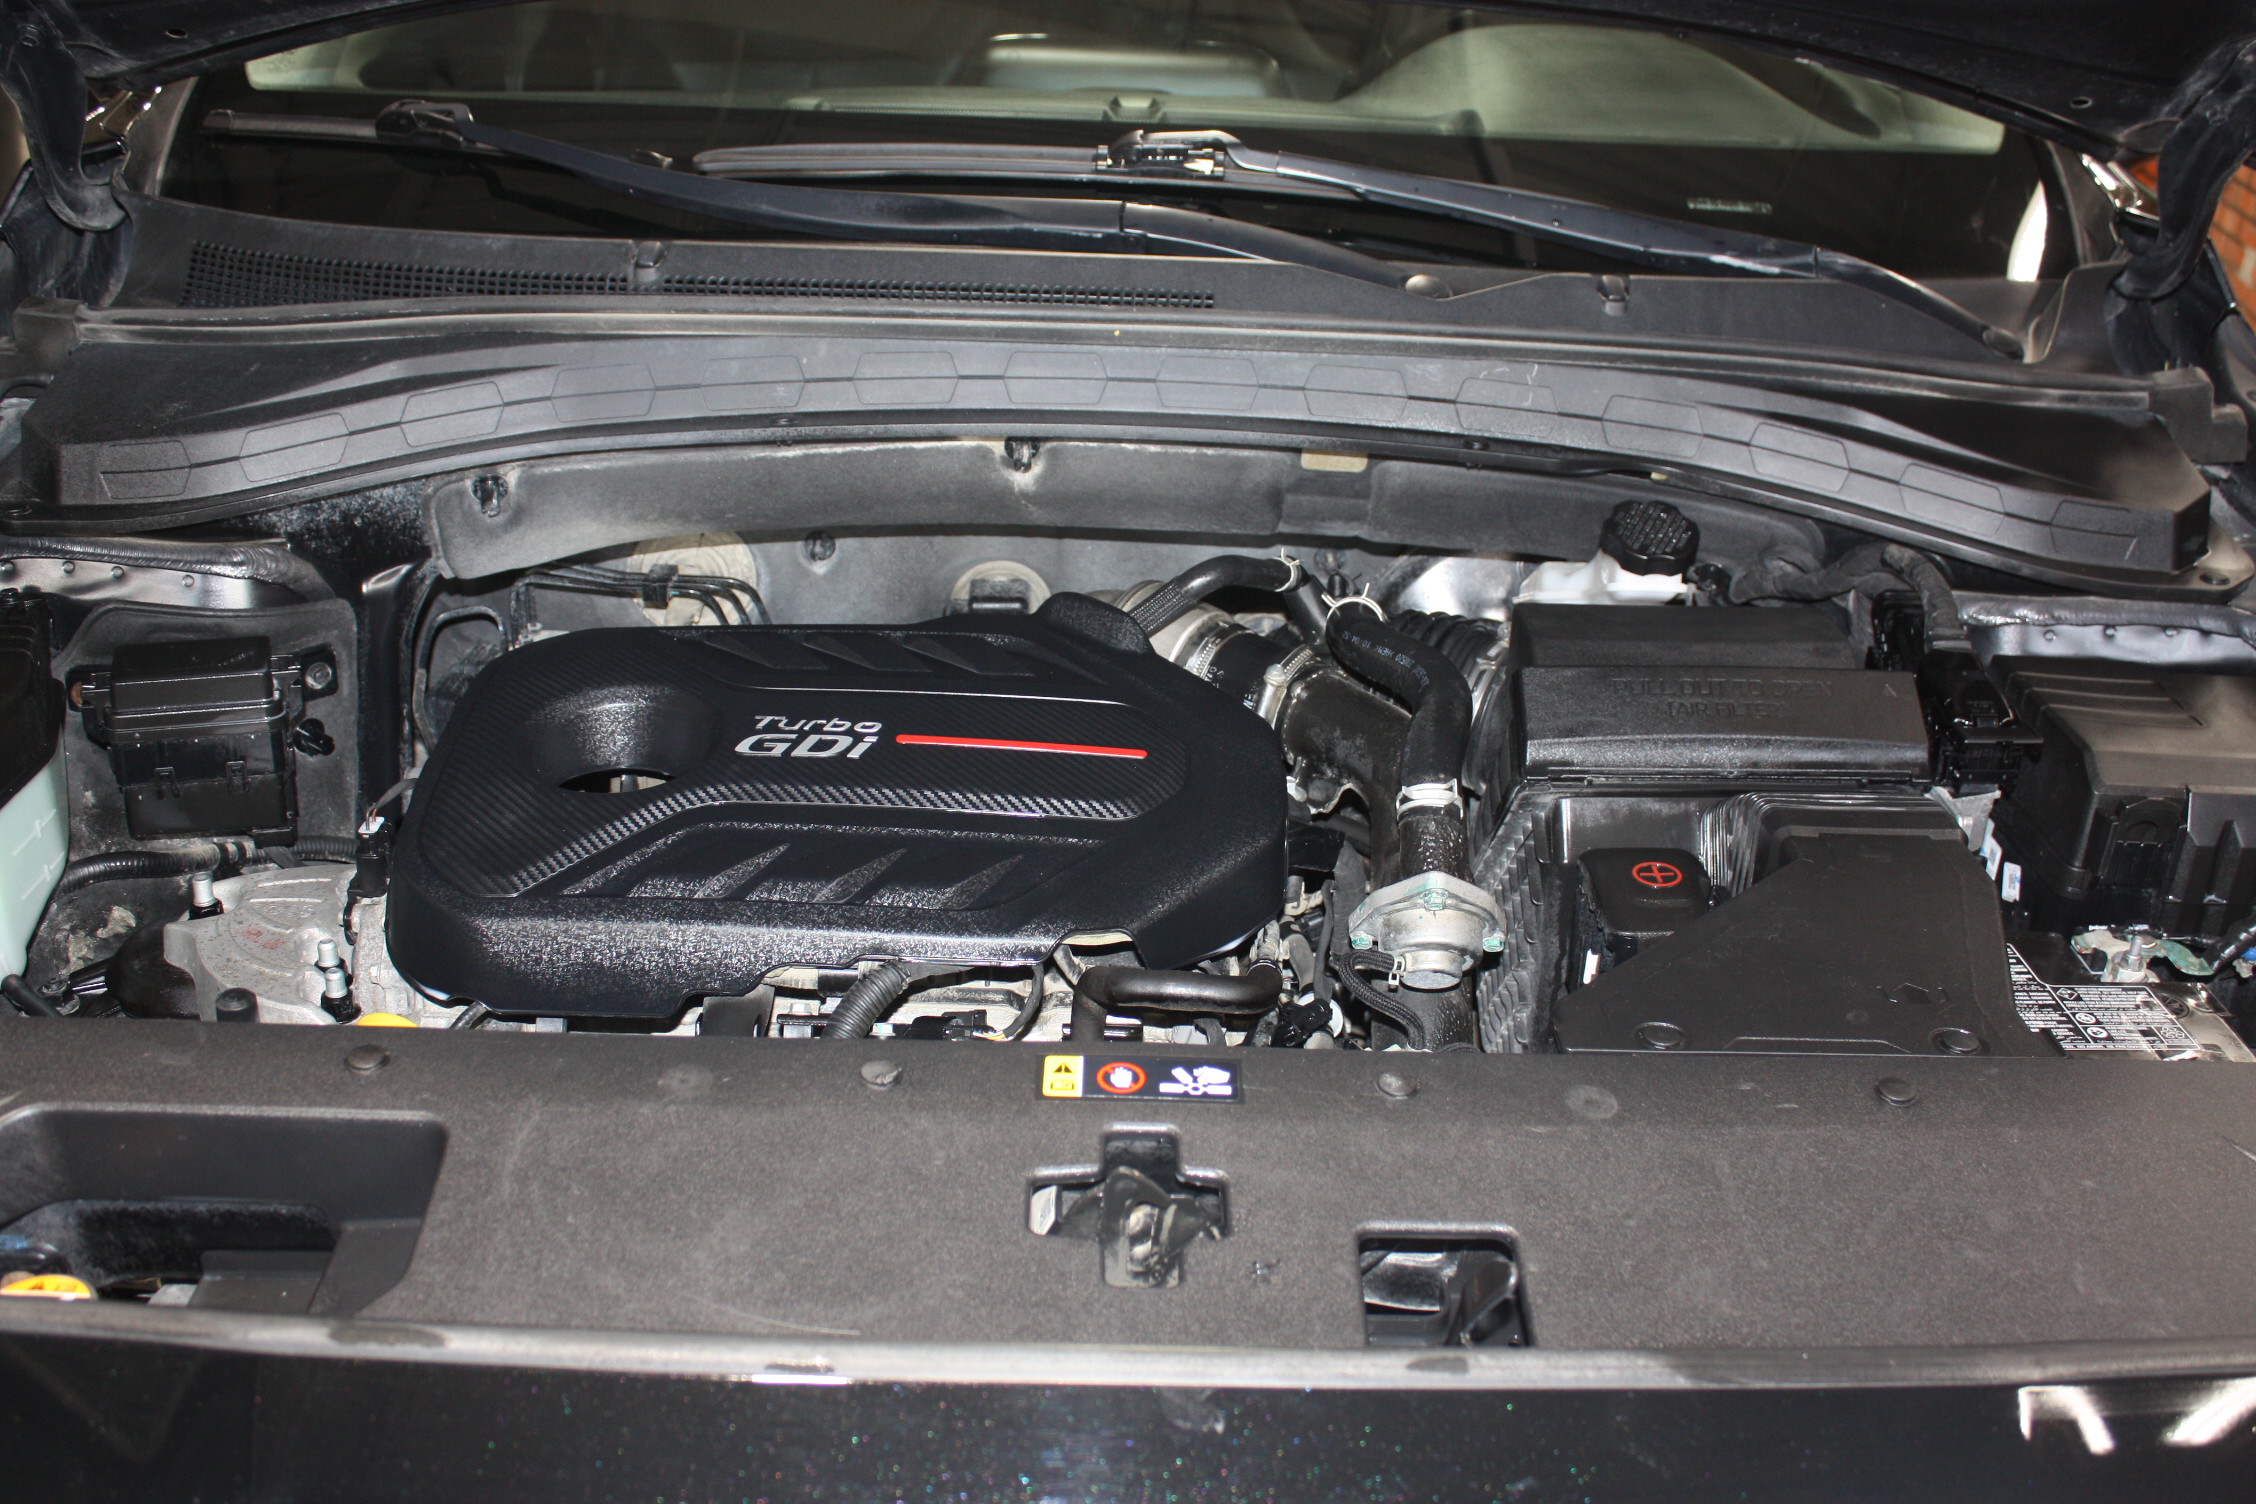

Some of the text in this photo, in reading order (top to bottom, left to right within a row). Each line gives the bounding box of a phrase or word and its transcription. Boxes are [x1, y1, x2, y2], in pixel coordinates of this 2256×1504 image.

[1611, 678, 1834, 697] PULL OUT TO OPEN
[754, 715, 883, 733] Turbo
[734, 733, 879, 759] GDi
